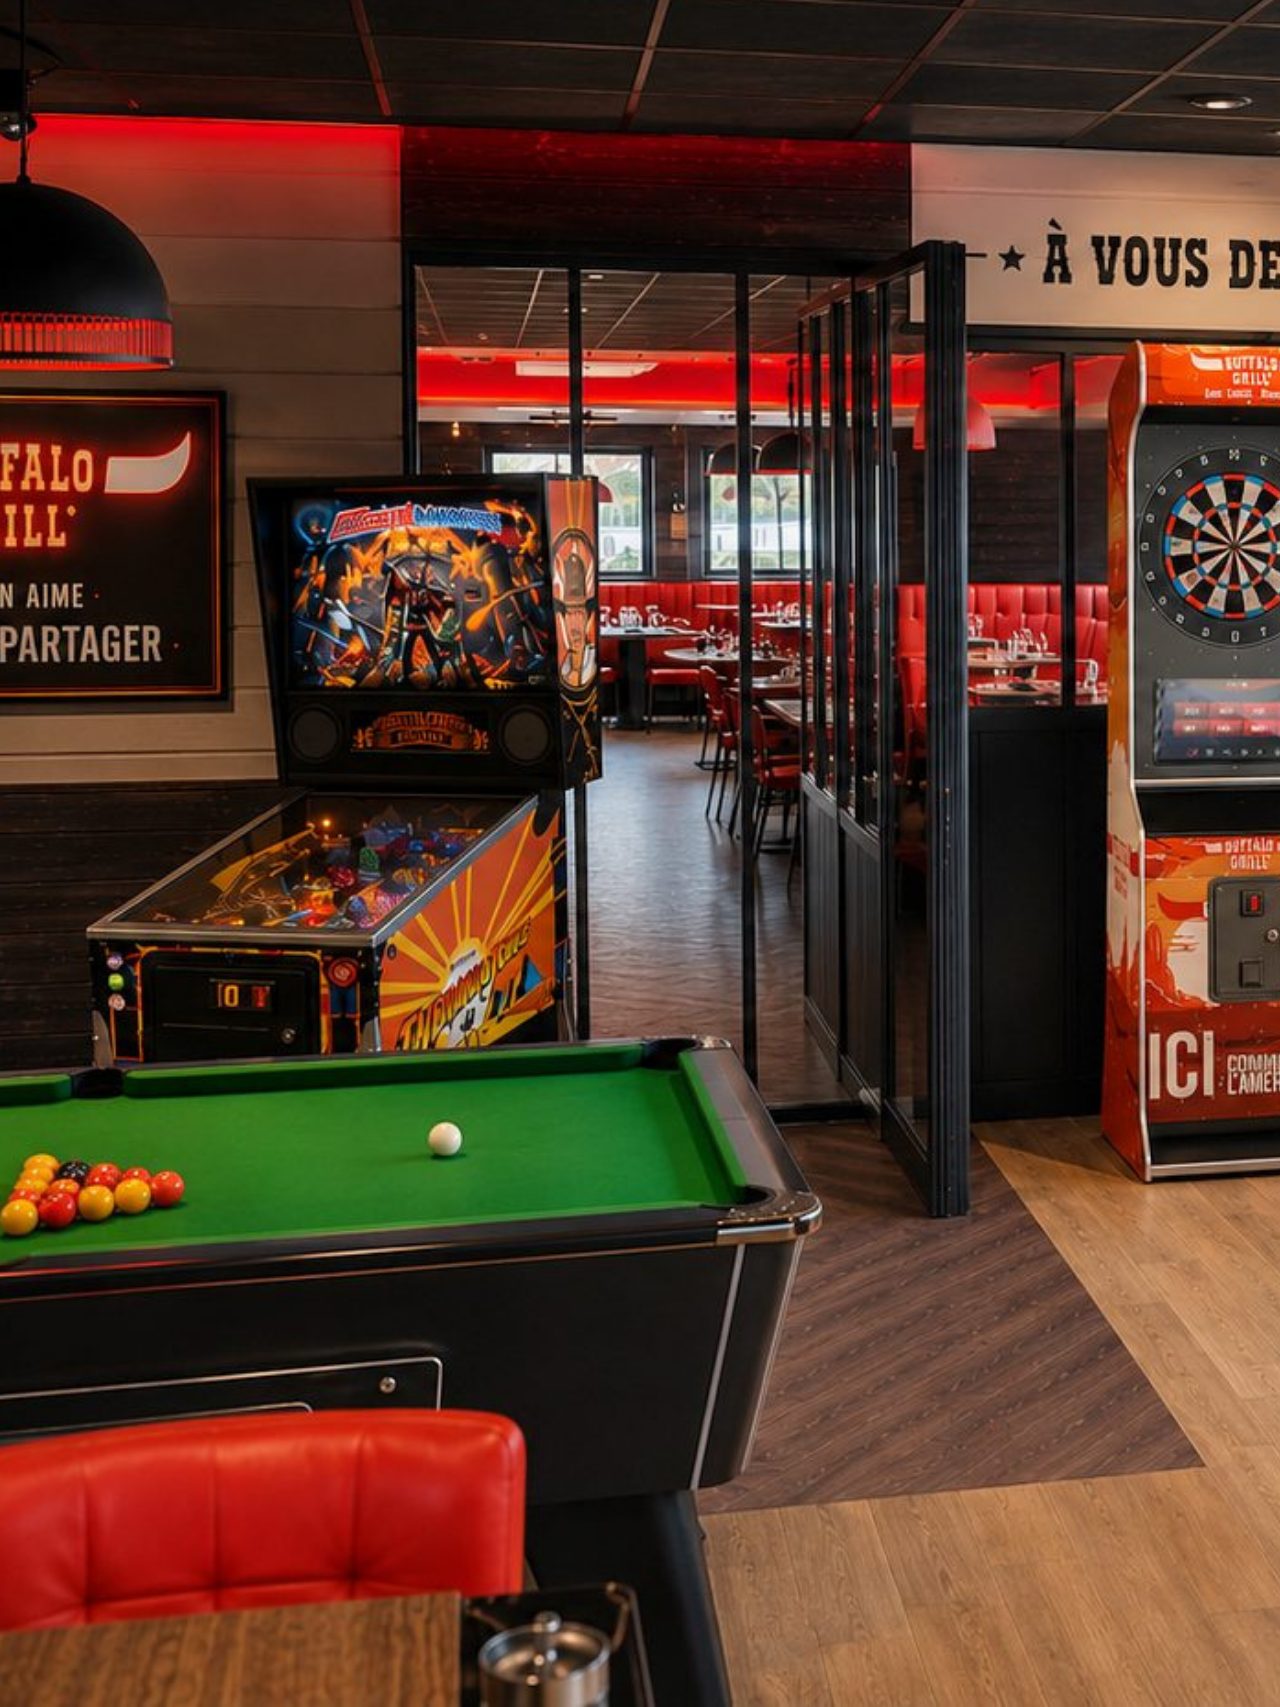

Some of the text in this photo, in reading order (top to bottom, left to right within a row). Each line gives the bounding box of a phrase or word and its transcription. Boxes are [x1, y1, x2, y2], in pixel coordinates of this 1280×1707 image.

[1043, 219, 1072, 283] À
[1091, 235, 1207, 287] VOUS
[0, 442, 94, 492] FALO
[26, 582, 84, 608] AIME
[0, 624, 162, 663] PARTAGER
[1149, 1030, 1214, 1100] ICI
